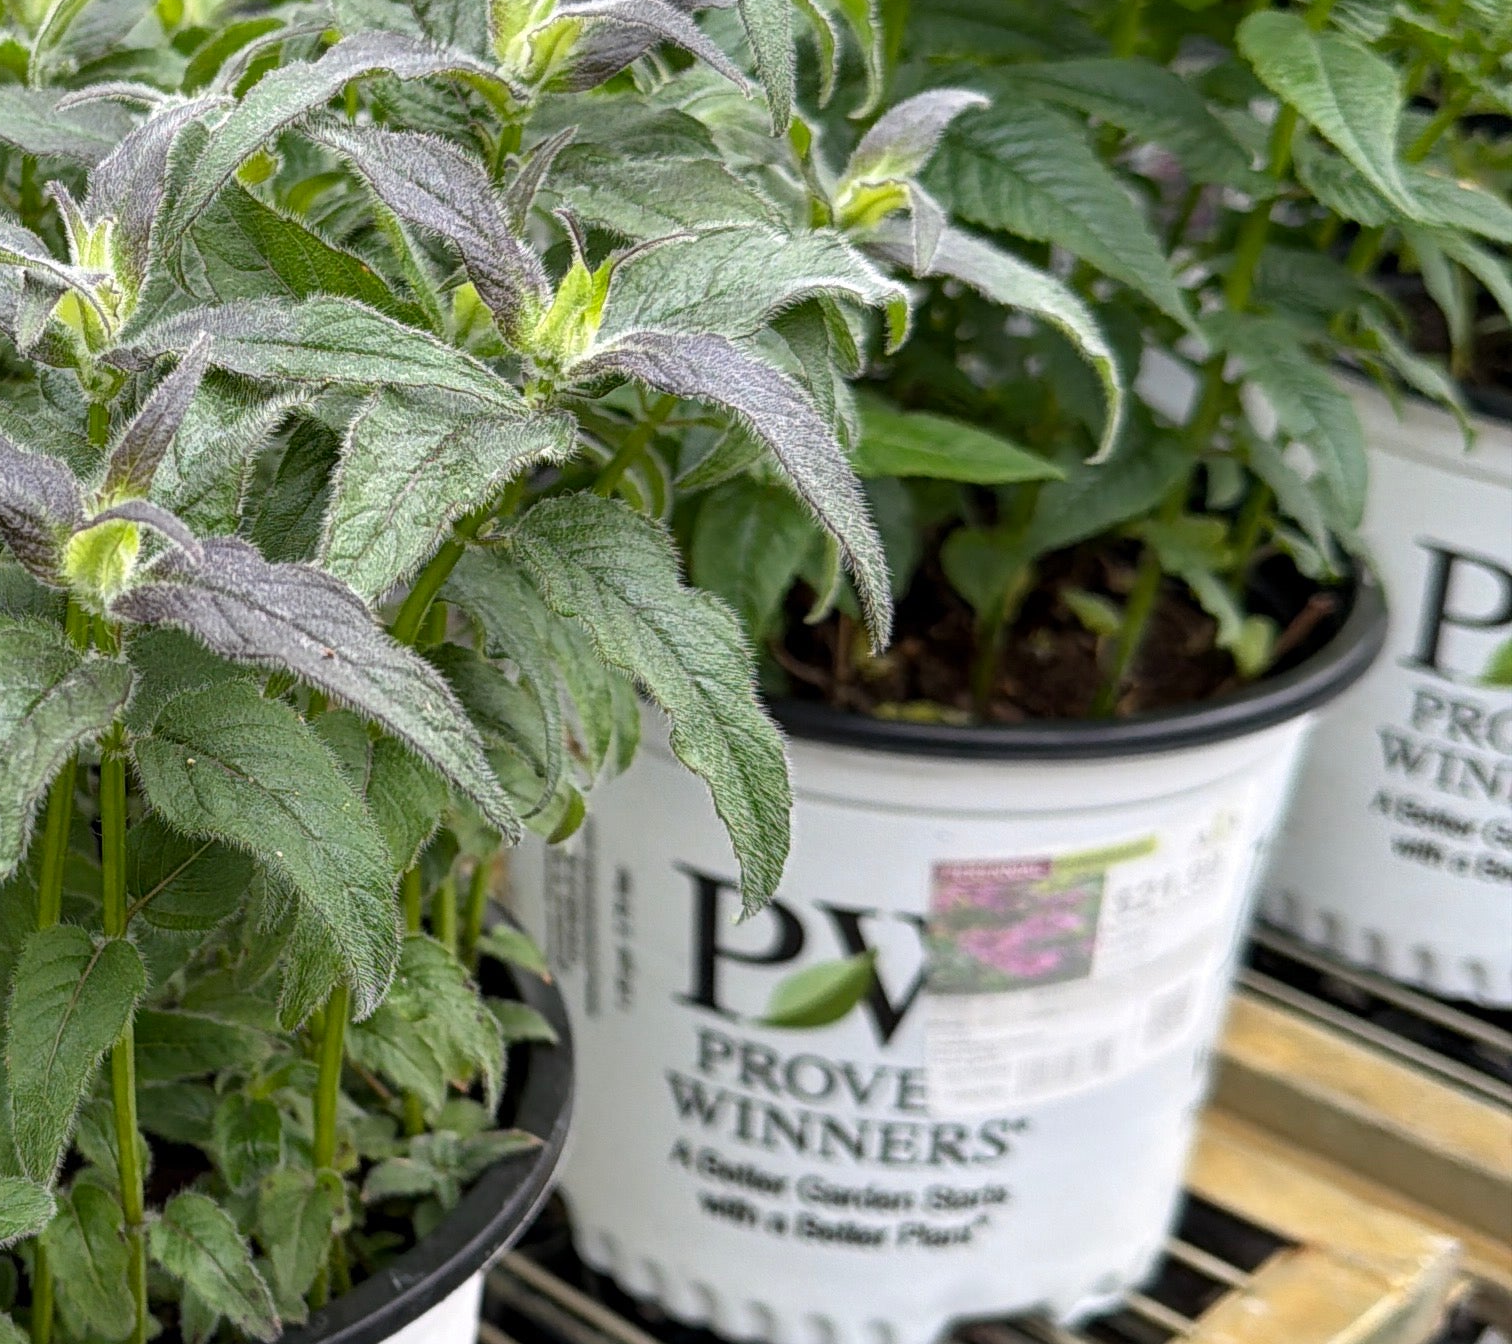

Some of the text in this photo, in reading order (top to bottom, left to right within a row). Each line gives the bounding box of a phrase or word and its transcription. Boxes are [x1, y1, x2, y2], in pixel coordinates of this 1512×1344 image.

[696, 1026, 929, 1115] PROVE
[665, 1068, 1010, 1166] WINNERS
[670, 1136, 1011, 1213] A Better Garden Starts
[697, 1188, 759, 1230] with
[764, 1211, 788, 1236] a
[793, 1211, 887, 1249] Better
